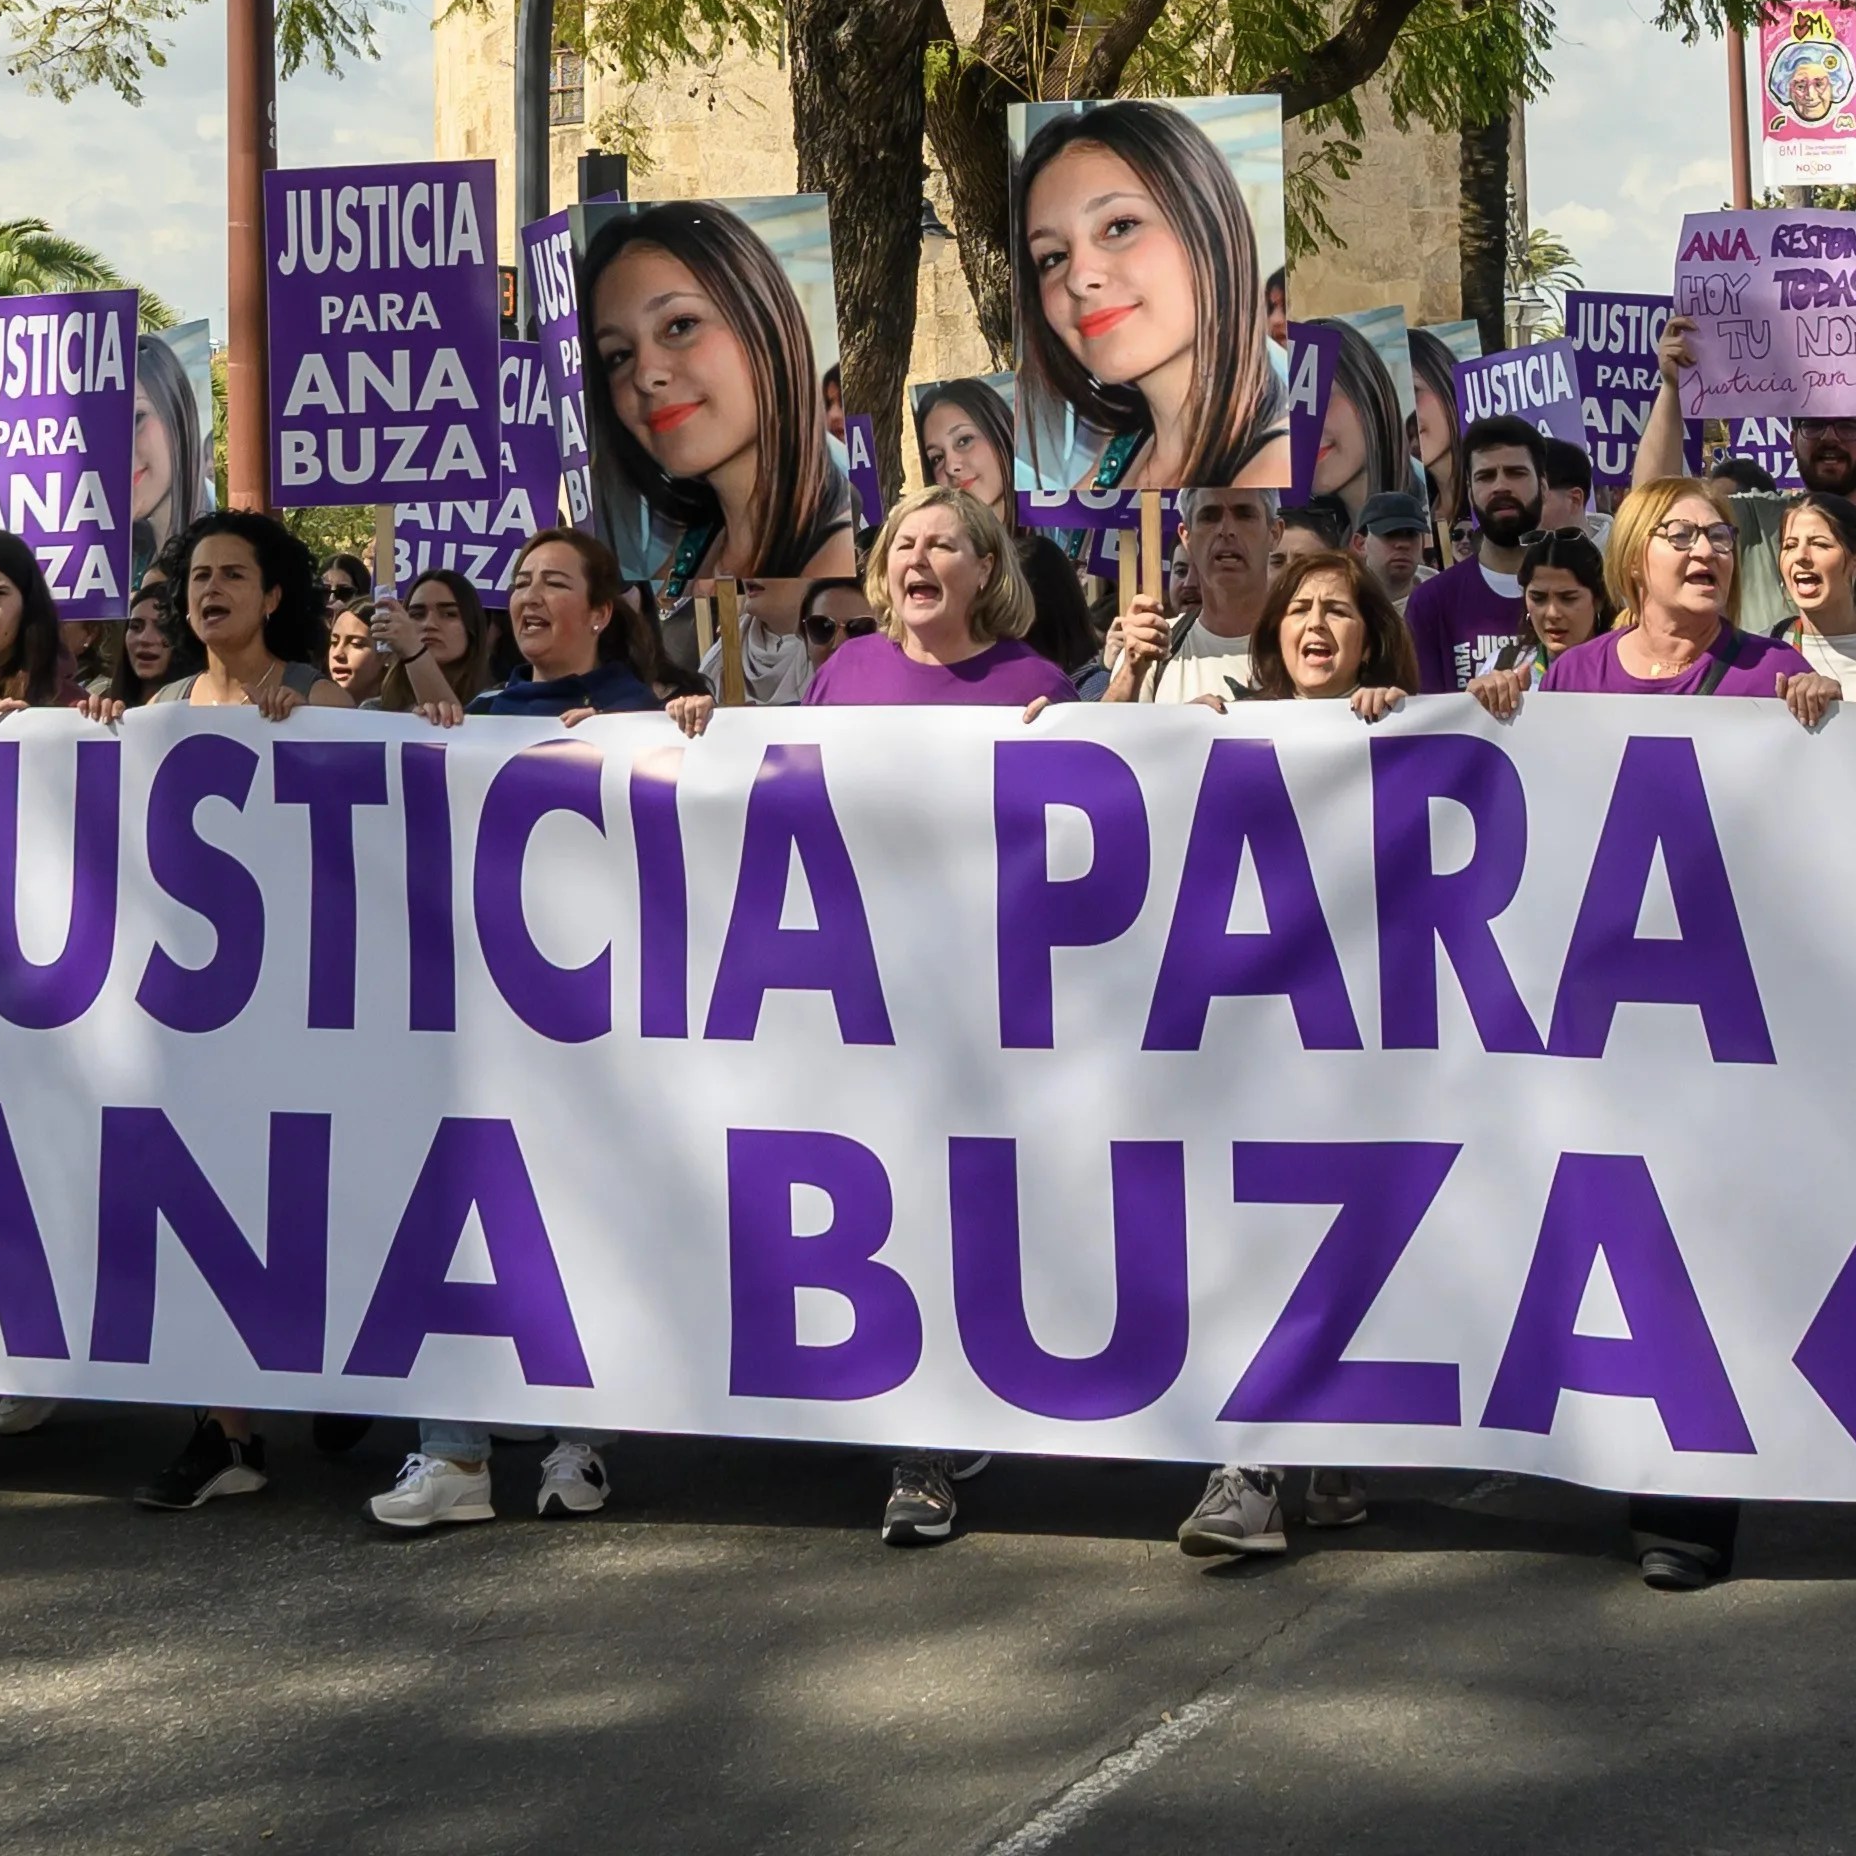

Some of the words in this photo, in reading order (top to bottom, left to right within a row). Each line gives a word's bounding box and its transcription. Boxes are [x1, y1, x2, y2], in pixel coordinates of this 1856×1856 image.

[278, 182, 484, 275] JUSTICIA
[1680, 227, 1761, 266] ANA,
[531, 230, 578, 326] JUST
[1680, 273, 1750, 315] HOY
[321, 292, 441, 334] PARA
[1572, 300, 1668, 355] JUSTIC
[1717, 319, 1771, 359] TU
[283, 348, 479, 416] ANA
[1465, 351, 1573, 424] JUSTICIA
[1679, 366, 1797, 415] Justicia
[1581, 397, 1654, 437] AN
[281, 424, 486, 485] BUZA
[35, 544, 120, 599] ZA
[1454, 642, 1472, 689] PARA
[994, 733, 1777, 1064] PARA
[726, 1129, 1757, 1455] BUZA
